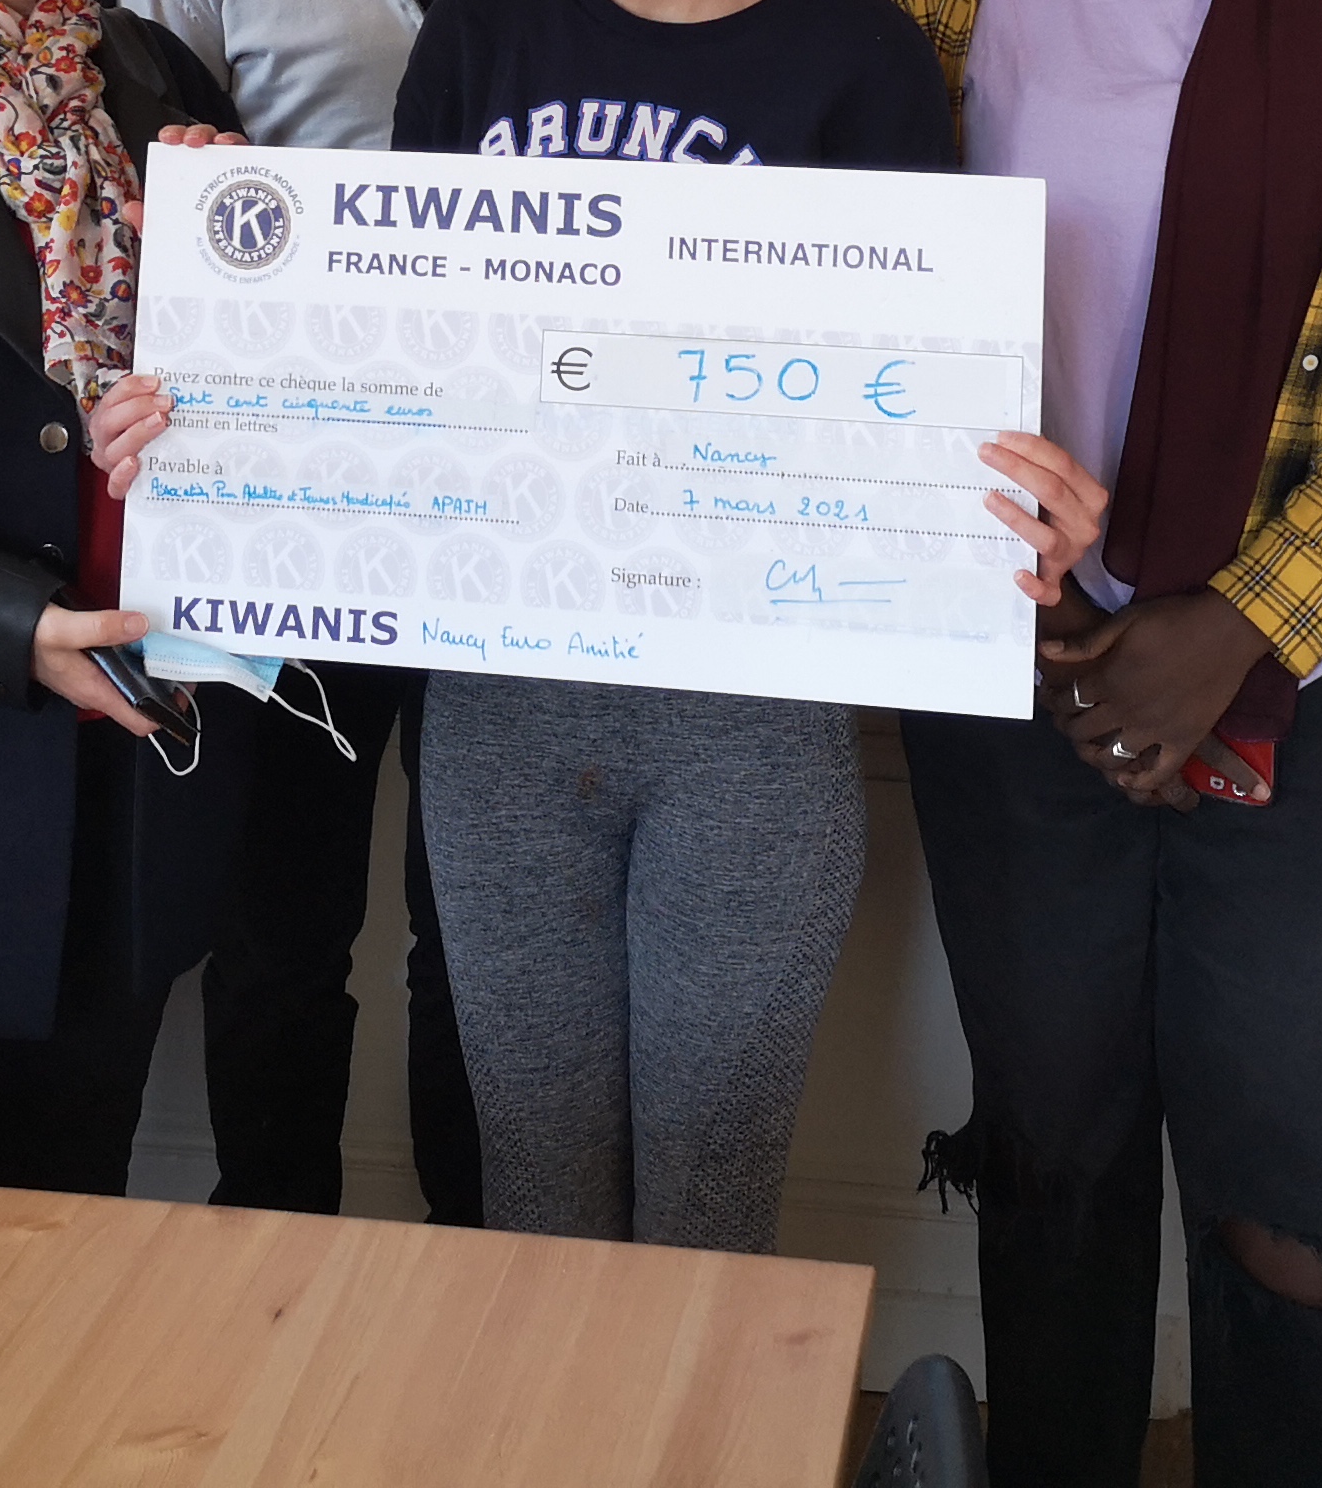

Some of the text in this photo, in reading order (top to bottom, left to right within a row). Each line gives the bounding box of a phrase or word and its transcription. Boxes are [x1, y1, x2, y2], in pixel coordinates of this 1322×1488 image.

[195, 165, 304, 215] DISTRICT FRANCE-MONACO
[223, 187, 278, 210] KIWANIS
[232, 198, 268, 251] K
[333, 182, 623, 239] KIWANIS
[213, 215, 284, 262] INTERNATIONAL
[668, 236, 934, 273] INTERNATIONAL
[327, 250, 448, 278] FRANCE
[484, 258, 621, 287] MONACO
[154, 367, 444, 397] Payez contre ce chèque la somme de
[551, 346, 594, 391] €
[678, 349, 917, 419] 750 €
[227, 394, 268, 409] cent
[386, 403, 434, 417] euros
[165, 414, 278, 434] ontant en lettres
[148, 456, 223, 475] Payable à
[616, 450, 662, 468] Fait à
[693, 442, 777, 469] Nancy
[614, 497, 649, 514] Date
[682, 489, 870, 522] 7 mars 2021
[611, 567, 691, 589] Signature
[172, 595, 399, 646] KIWANIS
[422, 617, 487, 660] Nancy
[502, 625, 552, 651] Euro
